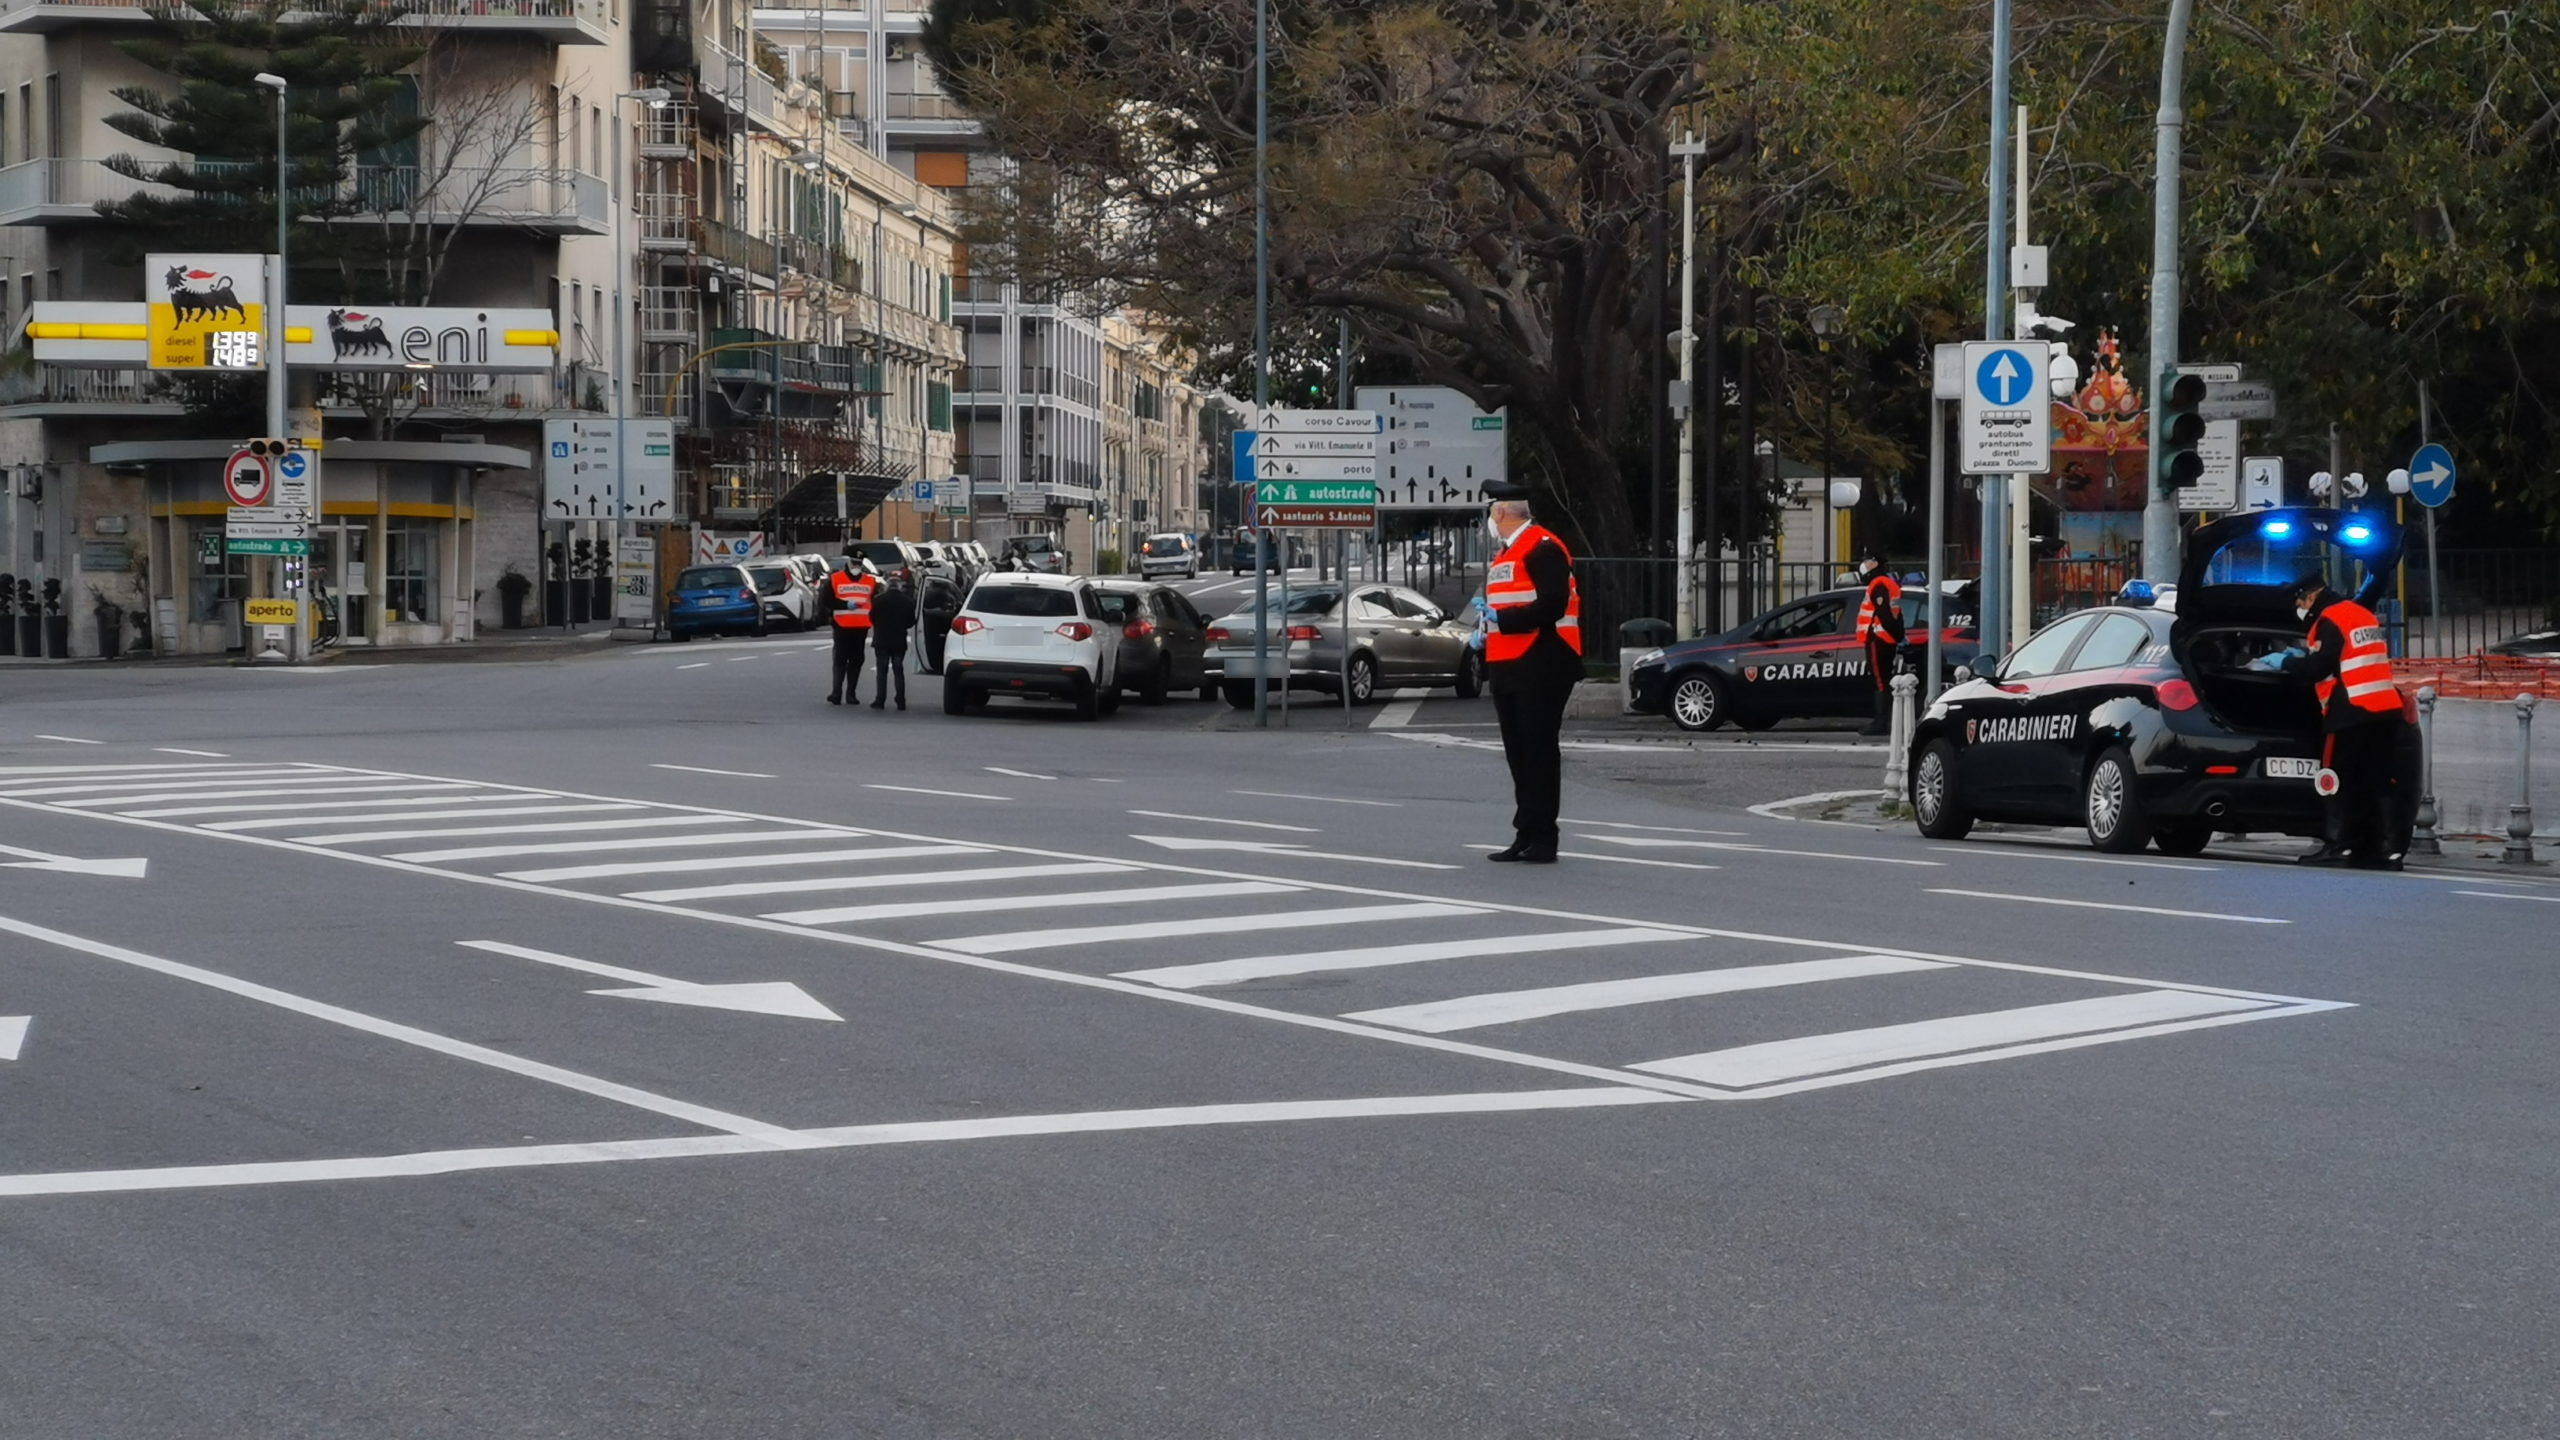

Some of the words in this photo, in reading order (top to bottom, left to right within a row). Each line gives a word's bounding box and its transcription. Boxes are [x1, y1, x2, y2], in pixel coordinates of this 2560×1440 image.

[165, 335, 196, 346] diesel
[400, 312, 487, 363] eni
[165, 355, 195, 365] super
[1305, 418, 1333, 426] corso
[1336, 416, 1372, 426] Cavour
[1988, 430, 2025, 438] autobus
[1294, 440, 1306, 450] via
[1329, 440, 1364, 450] Emanuele
[1978, 440, 2034, 449] granturismo
[1991, 449, 2020, 457] diretti
[1972, 459, 2000, 468] piazza
[2007, 458, 2039, 467] Duomo
[1343, 465, 1372, 475] porto
[1282, 511, 1325, 521] santuario
[1329, 510, 1372, 521] S.Antonio
[248, 604, 294, 617] aperto
[1948, 613, 1973, 626] 112
[2139, 645, 2169, 663] 112
[1979, 714, 2078, 743] CARABINIERI
[2270, 759, 2288, 775] CC
